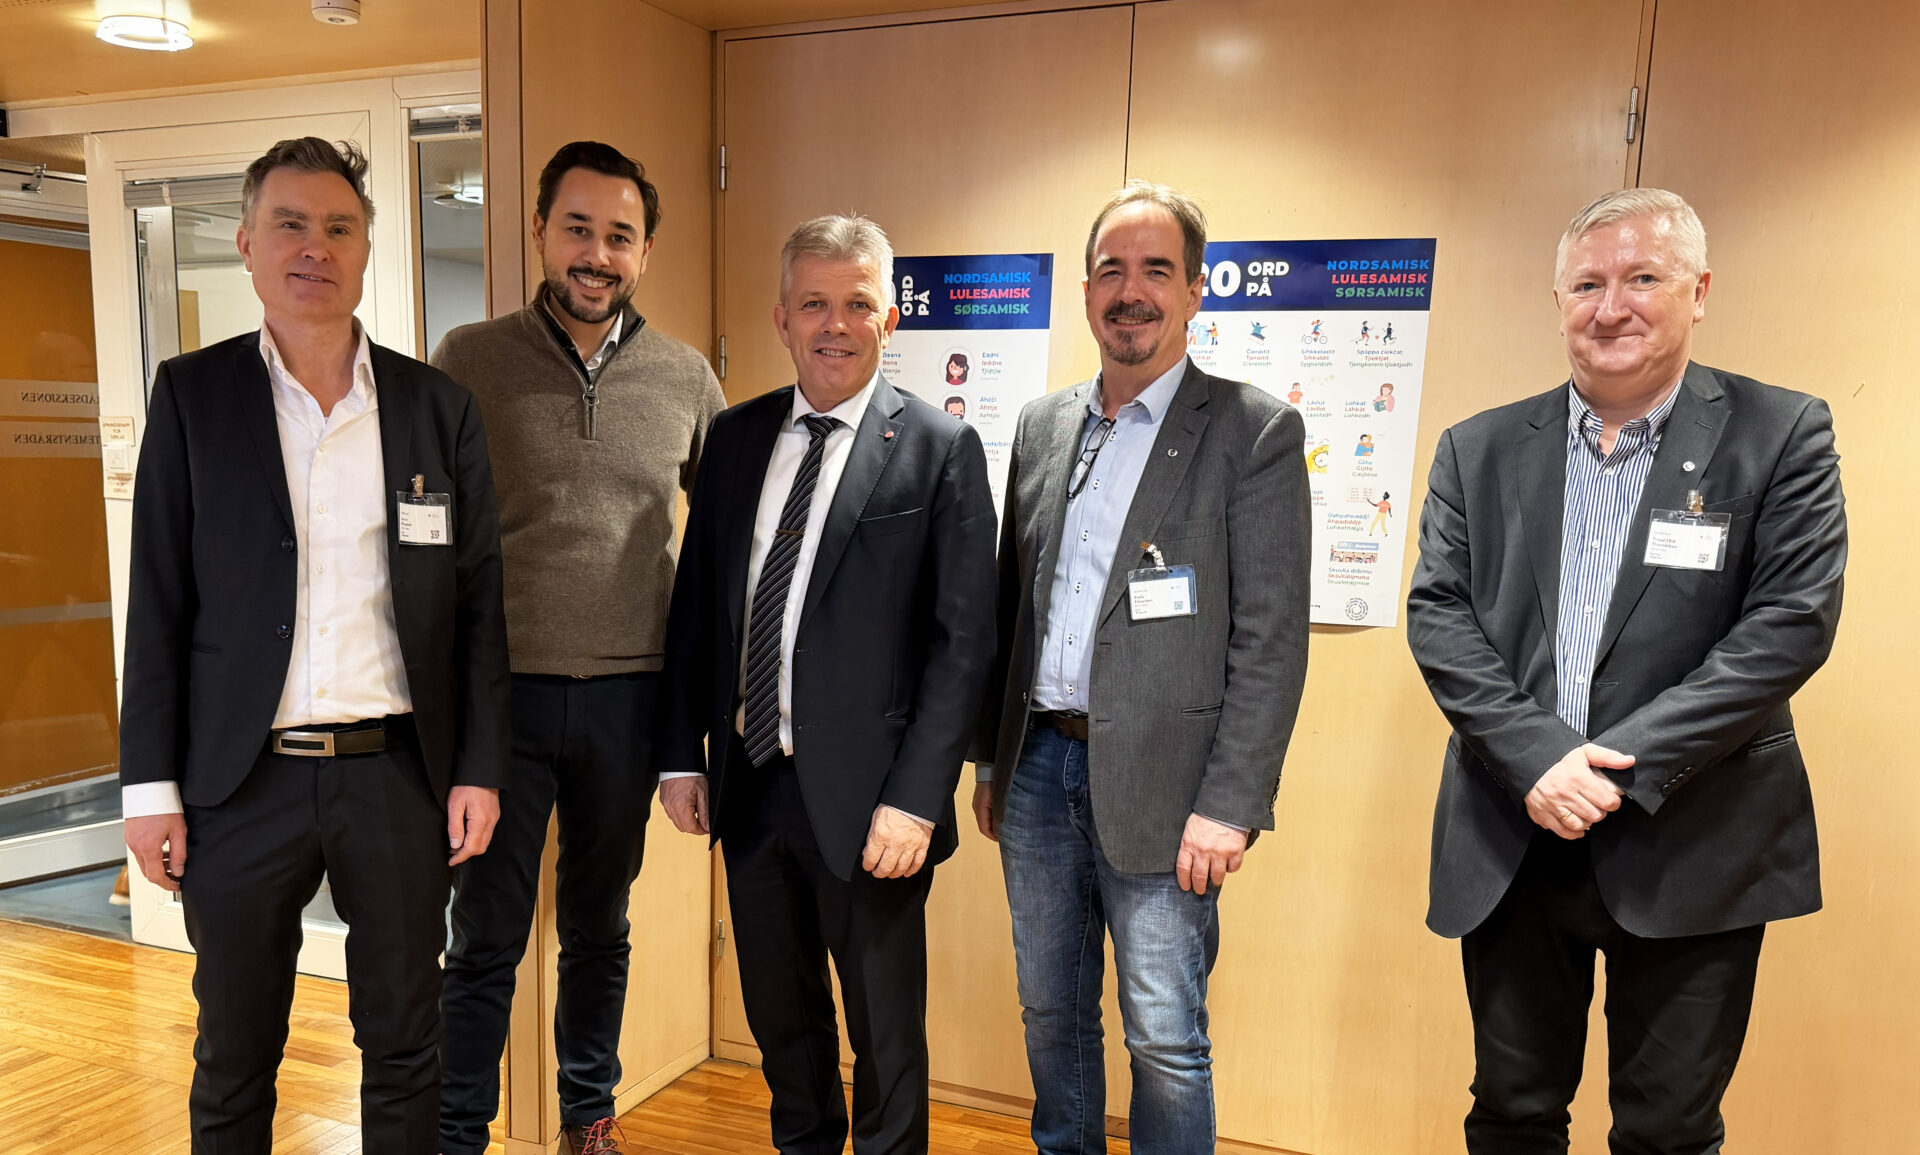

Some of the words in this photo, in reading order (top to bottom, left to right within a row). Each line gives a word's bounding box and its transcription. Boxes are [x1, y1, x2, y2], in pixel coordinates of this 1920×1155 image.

[1247, 261, 1290, 277] ORD
[1327, 259, 1430, 271] NORDSAMISK
[944, 272, 1031, 284] NORDSAMISK
[1331, 273, 1428, 284] LULESAMISK
[1246, 277, 1273, 297] PÅ
[1335, 286, 1425, 298] SØRSAMISK
[901, 275, 914, 316] ORD
[949, 287, 1031, 300] LULESAMISK
[914, 290, 930, 316] PÅ
[954, 303, 1030, 315] SØRSAMISK
